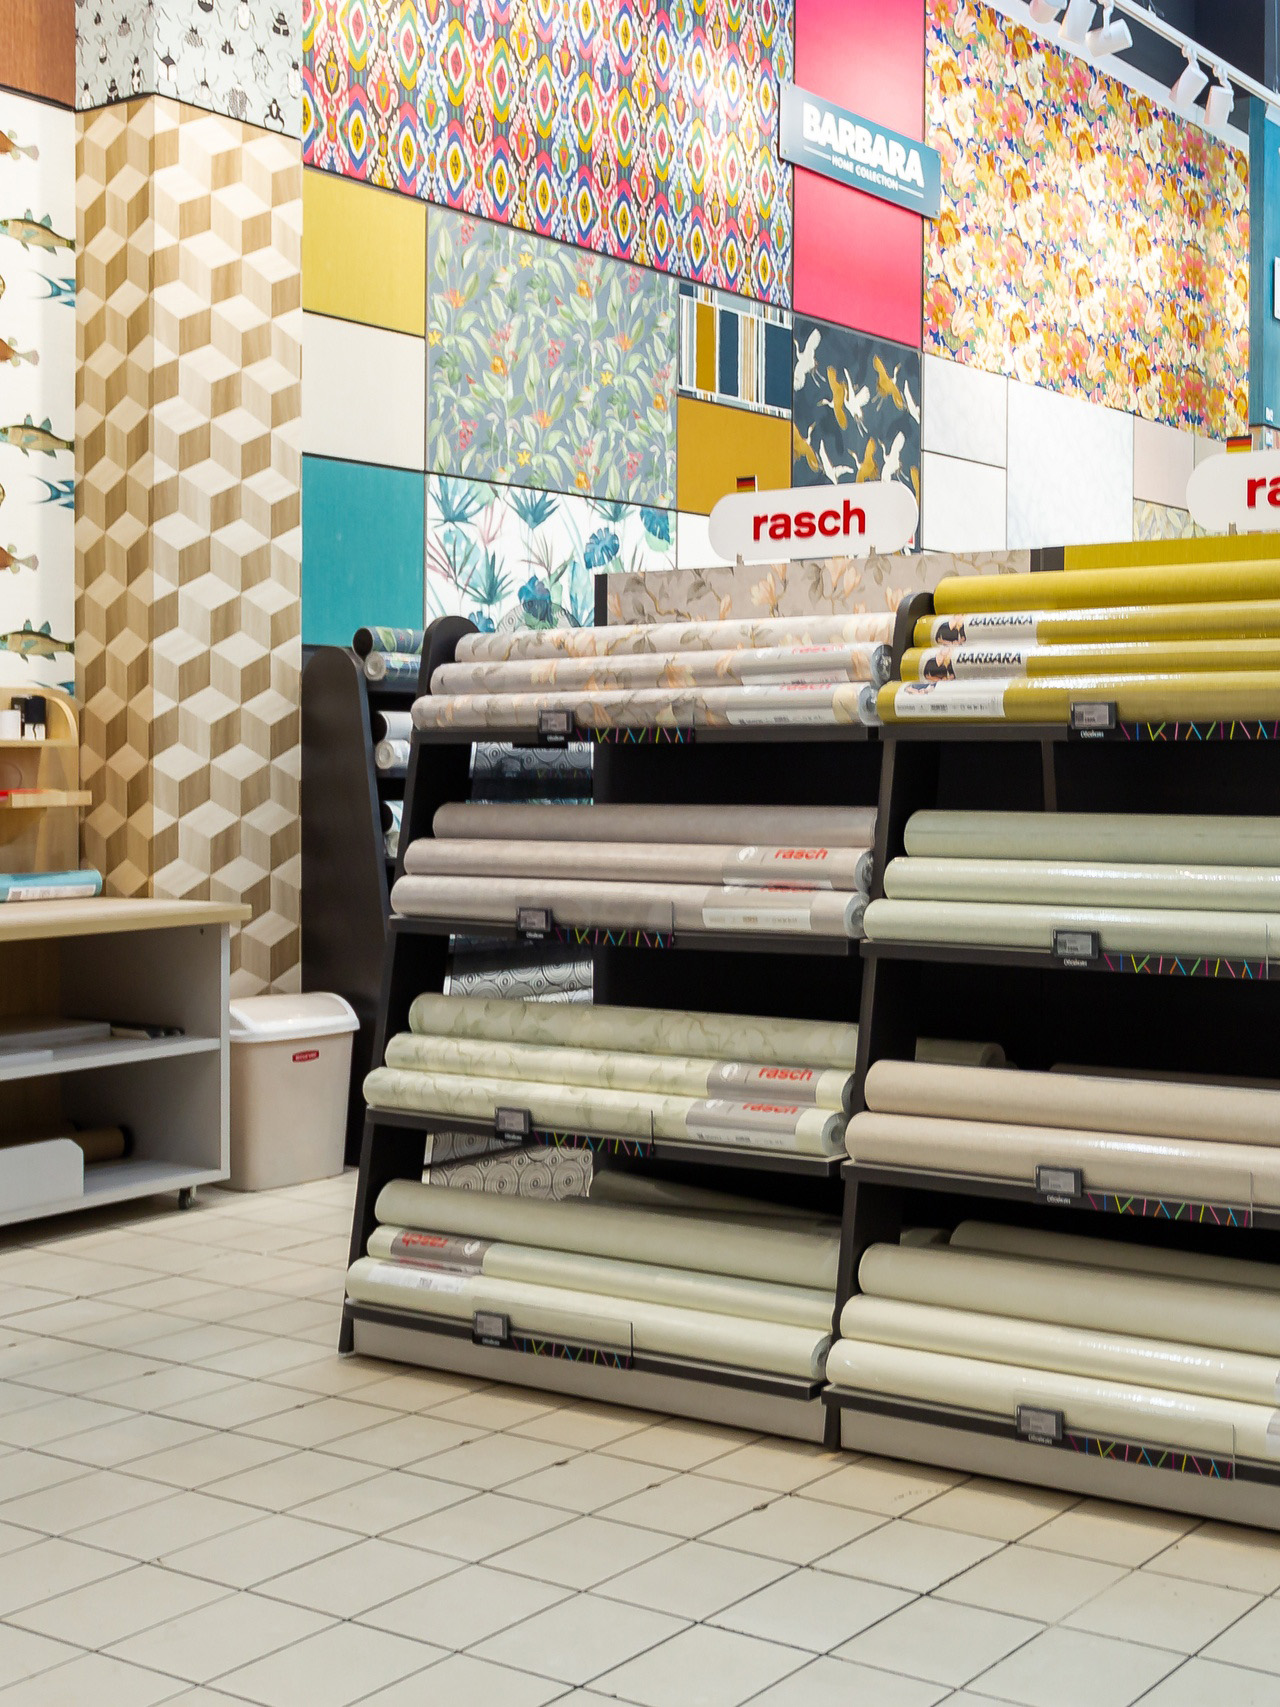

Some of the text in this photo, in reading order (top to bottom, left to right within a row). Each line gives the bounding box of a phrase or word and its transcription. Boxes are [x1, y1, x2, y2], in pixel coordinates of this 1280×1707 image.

[803, 102, 925, 189] BARBARA
[832, 154, 900, 192] HOME COLLECTION
[752, 499, 866, 542] rasch
[956, 652, 1022, 665] BARBARA
[774, 848, 828, 860] rasch
[758, 1067, 813, 1081] rasch
